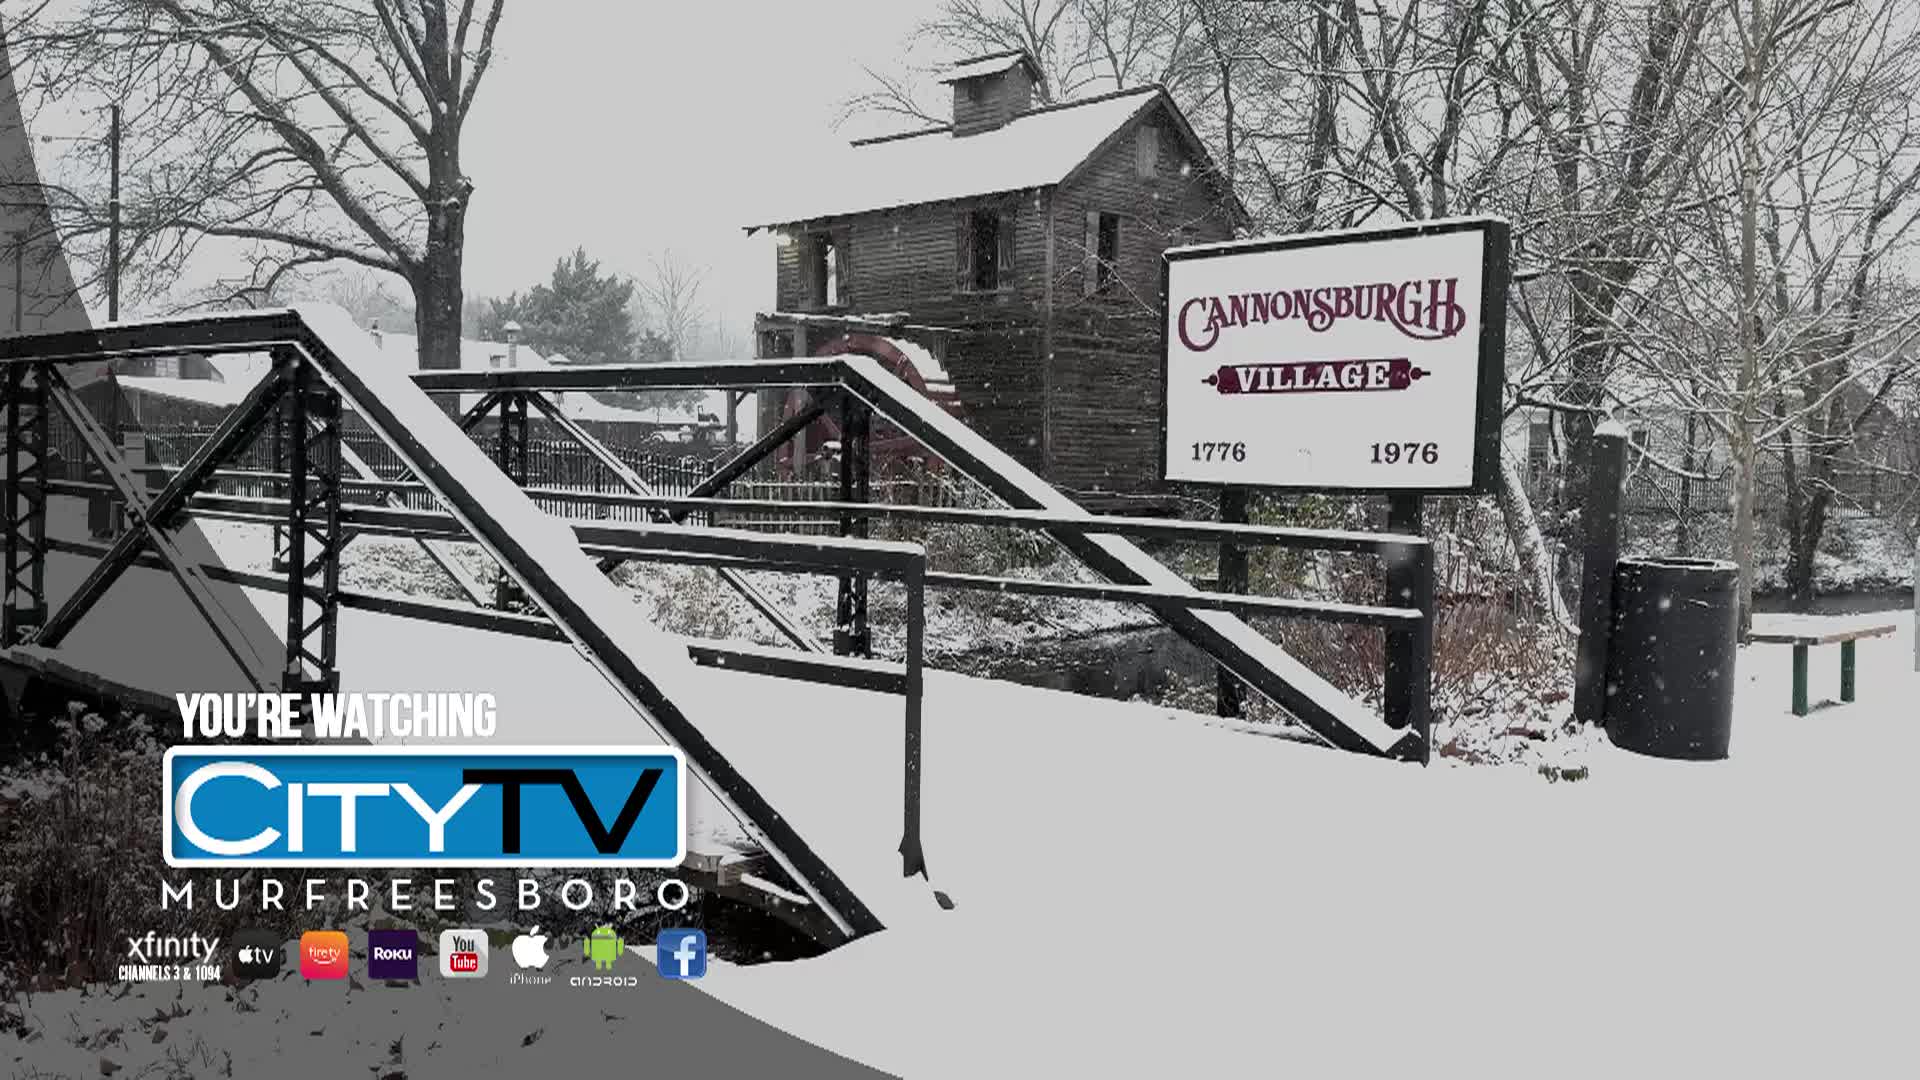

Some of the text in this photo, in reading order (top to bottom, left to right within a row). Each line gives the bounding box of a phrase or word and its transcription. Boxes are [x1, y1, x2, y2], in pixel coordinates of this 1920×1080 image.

[1178, 278, 1466, 352] CANNONSBURGH
[1235, 361, 1391, 392] VILLAGE
[1191, 442, 1438, 465] 1776 1976
